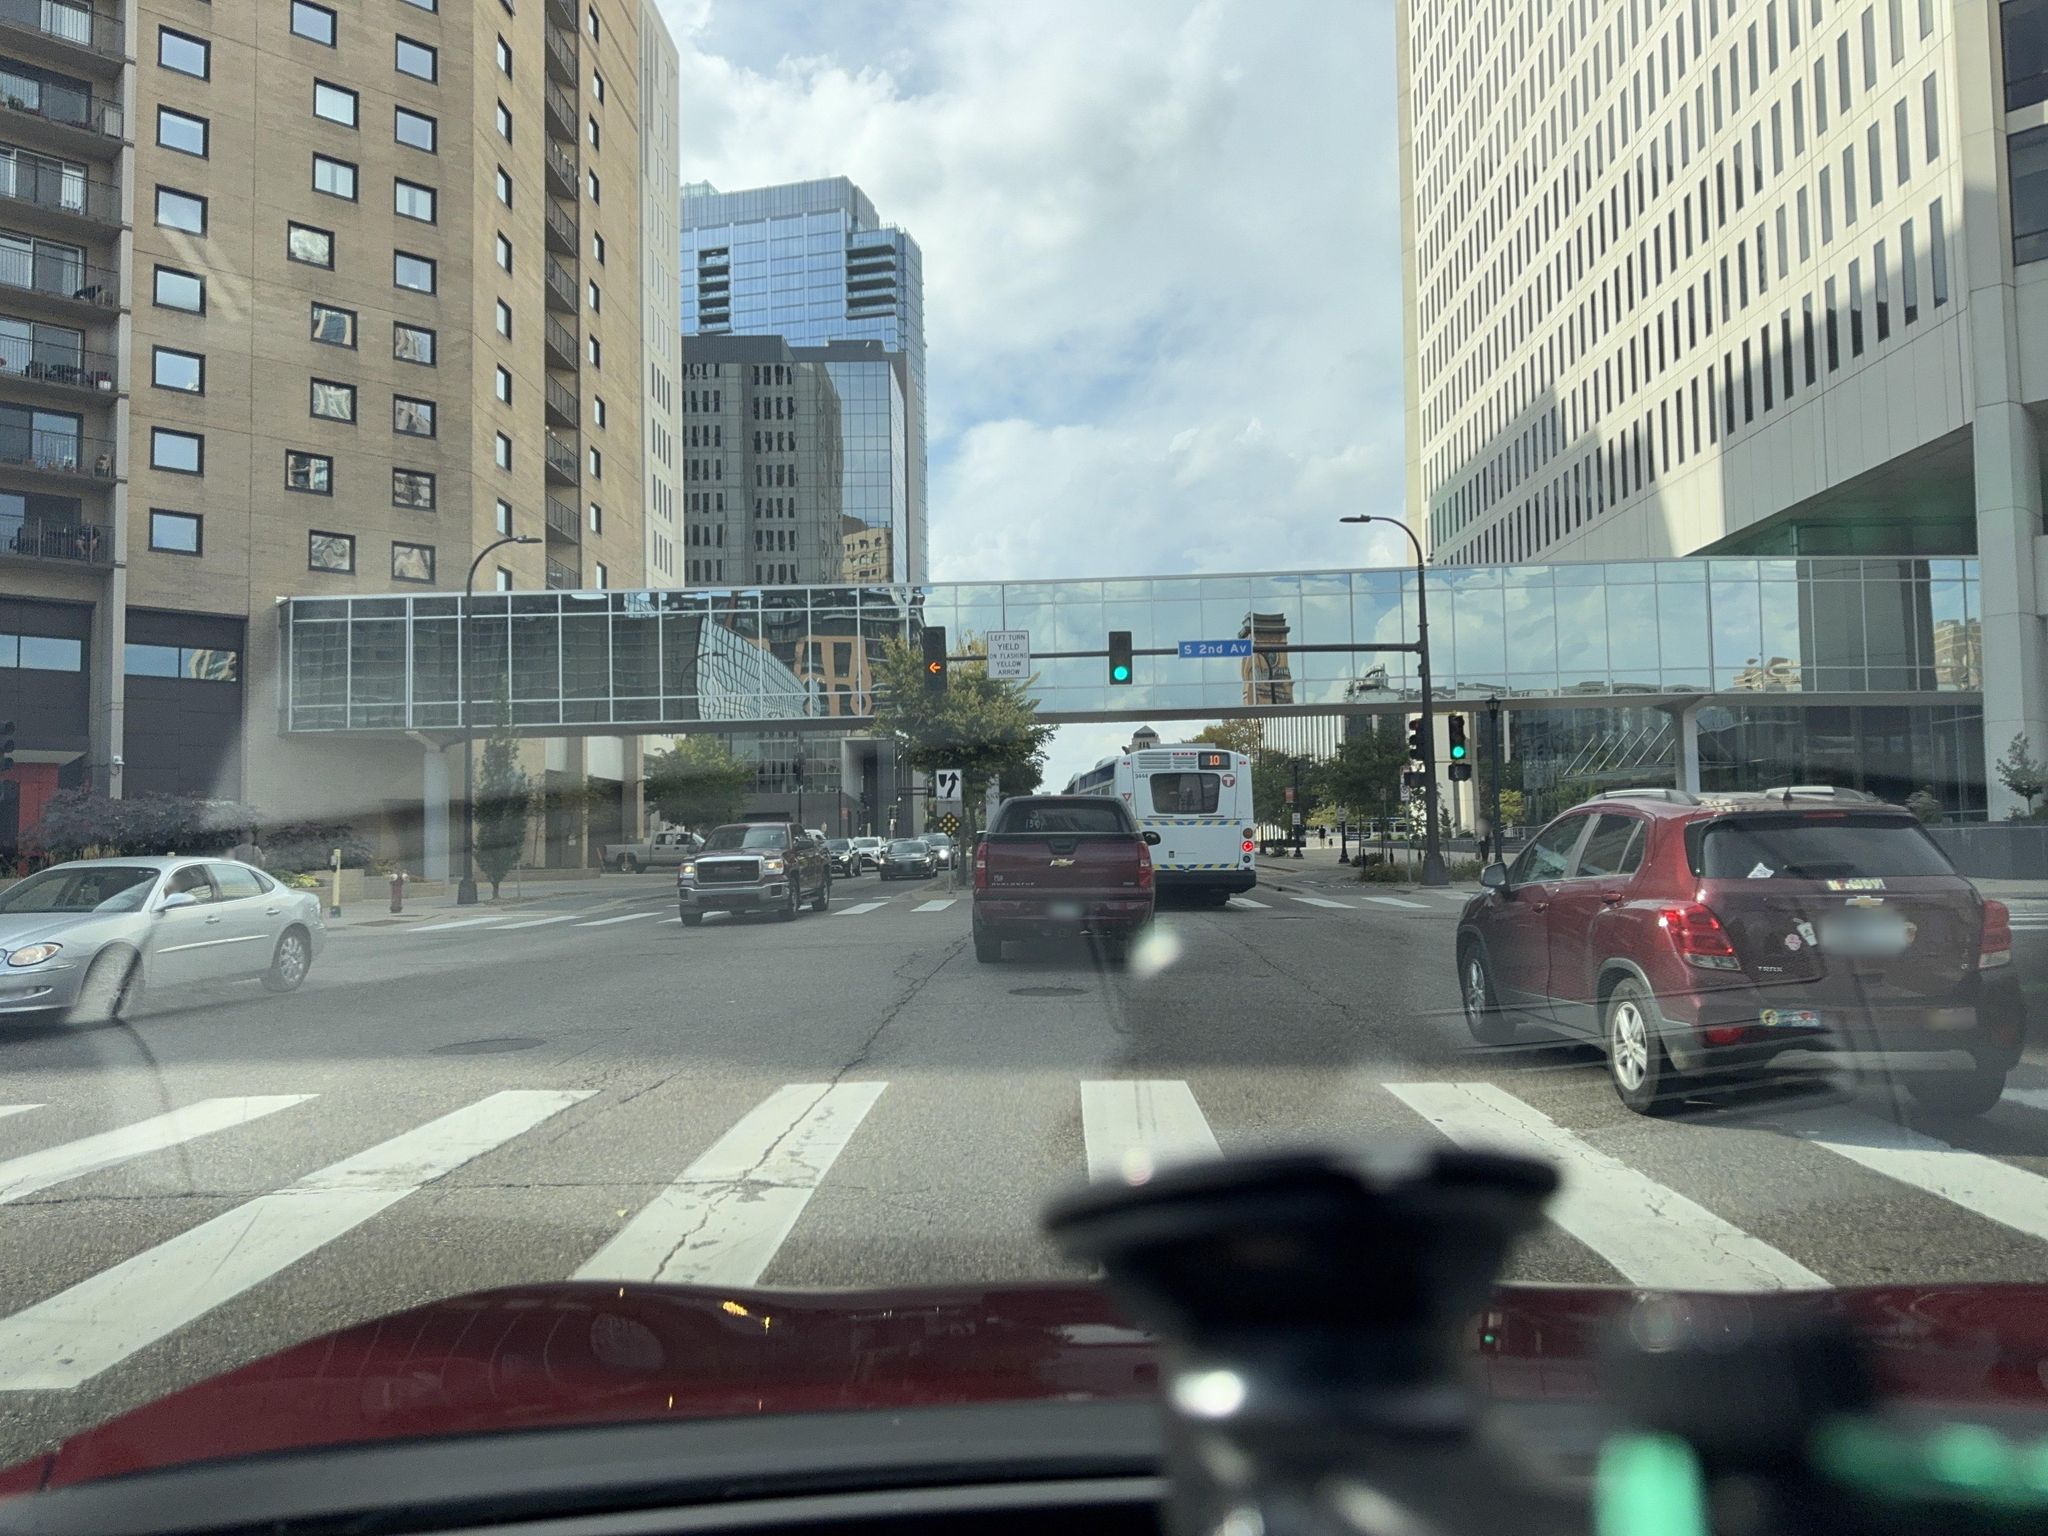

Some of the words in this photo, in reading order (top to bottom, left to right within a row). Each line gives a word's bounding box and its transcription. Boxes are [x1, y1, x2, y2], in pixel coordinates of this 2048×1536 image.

[1184, 645, 1192, 655] S
[1199, 643, 1223, 654] 2nd
[1230, 643, 1247, 653] Av
[1209, 754, 1220, 766] 10
